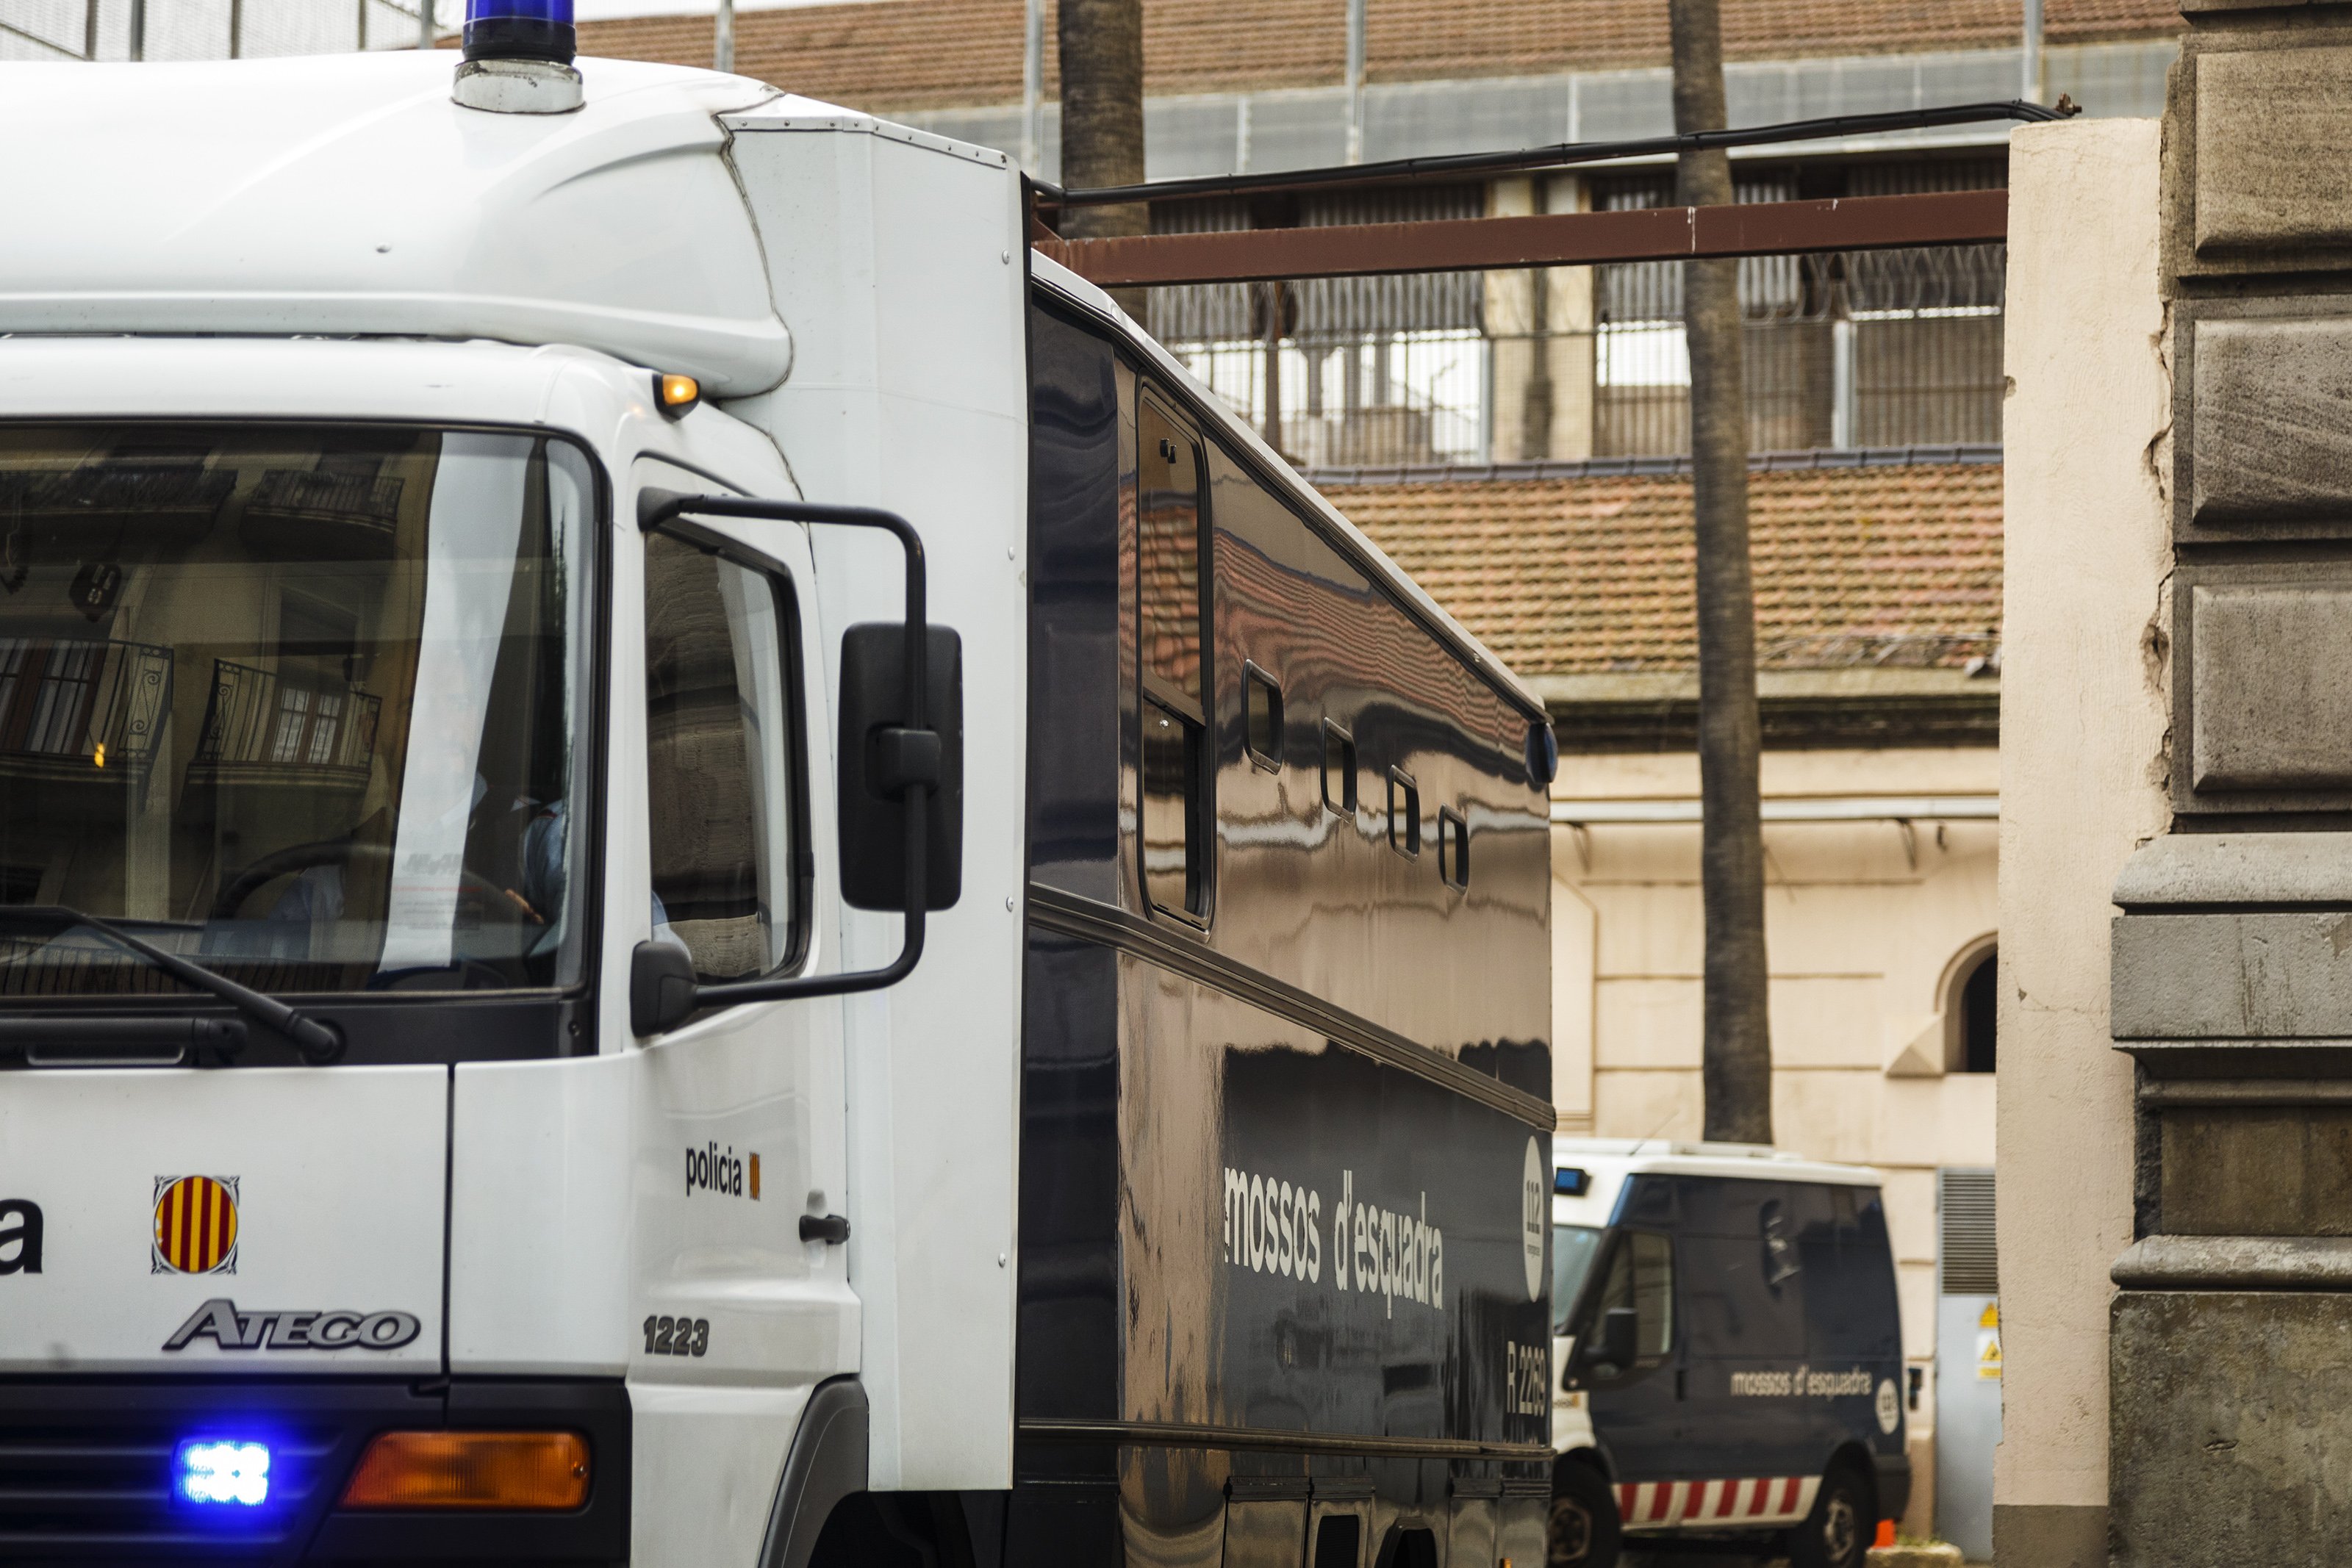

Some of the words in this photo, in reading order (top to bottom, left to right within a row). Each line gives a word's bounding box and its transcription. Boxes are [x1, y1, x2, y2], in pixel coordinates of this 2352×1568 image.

[686, 1141, 742, 1197] policia
[1526, 1180, 1541, 1235] 112
[1225, 1167, 1321, 1284] mossos
[1334, 1169, 1442, 1319] d'esquadra
[643, 1314, 709, 1357] 1223
[1507, 1341, 1516, 1413] R
[1519, 1345, 1546, 1417] 2269
[1730, 1371, 1791, 1396] mossos
[1793, 1364, 1873, 1403] d'esquadra
